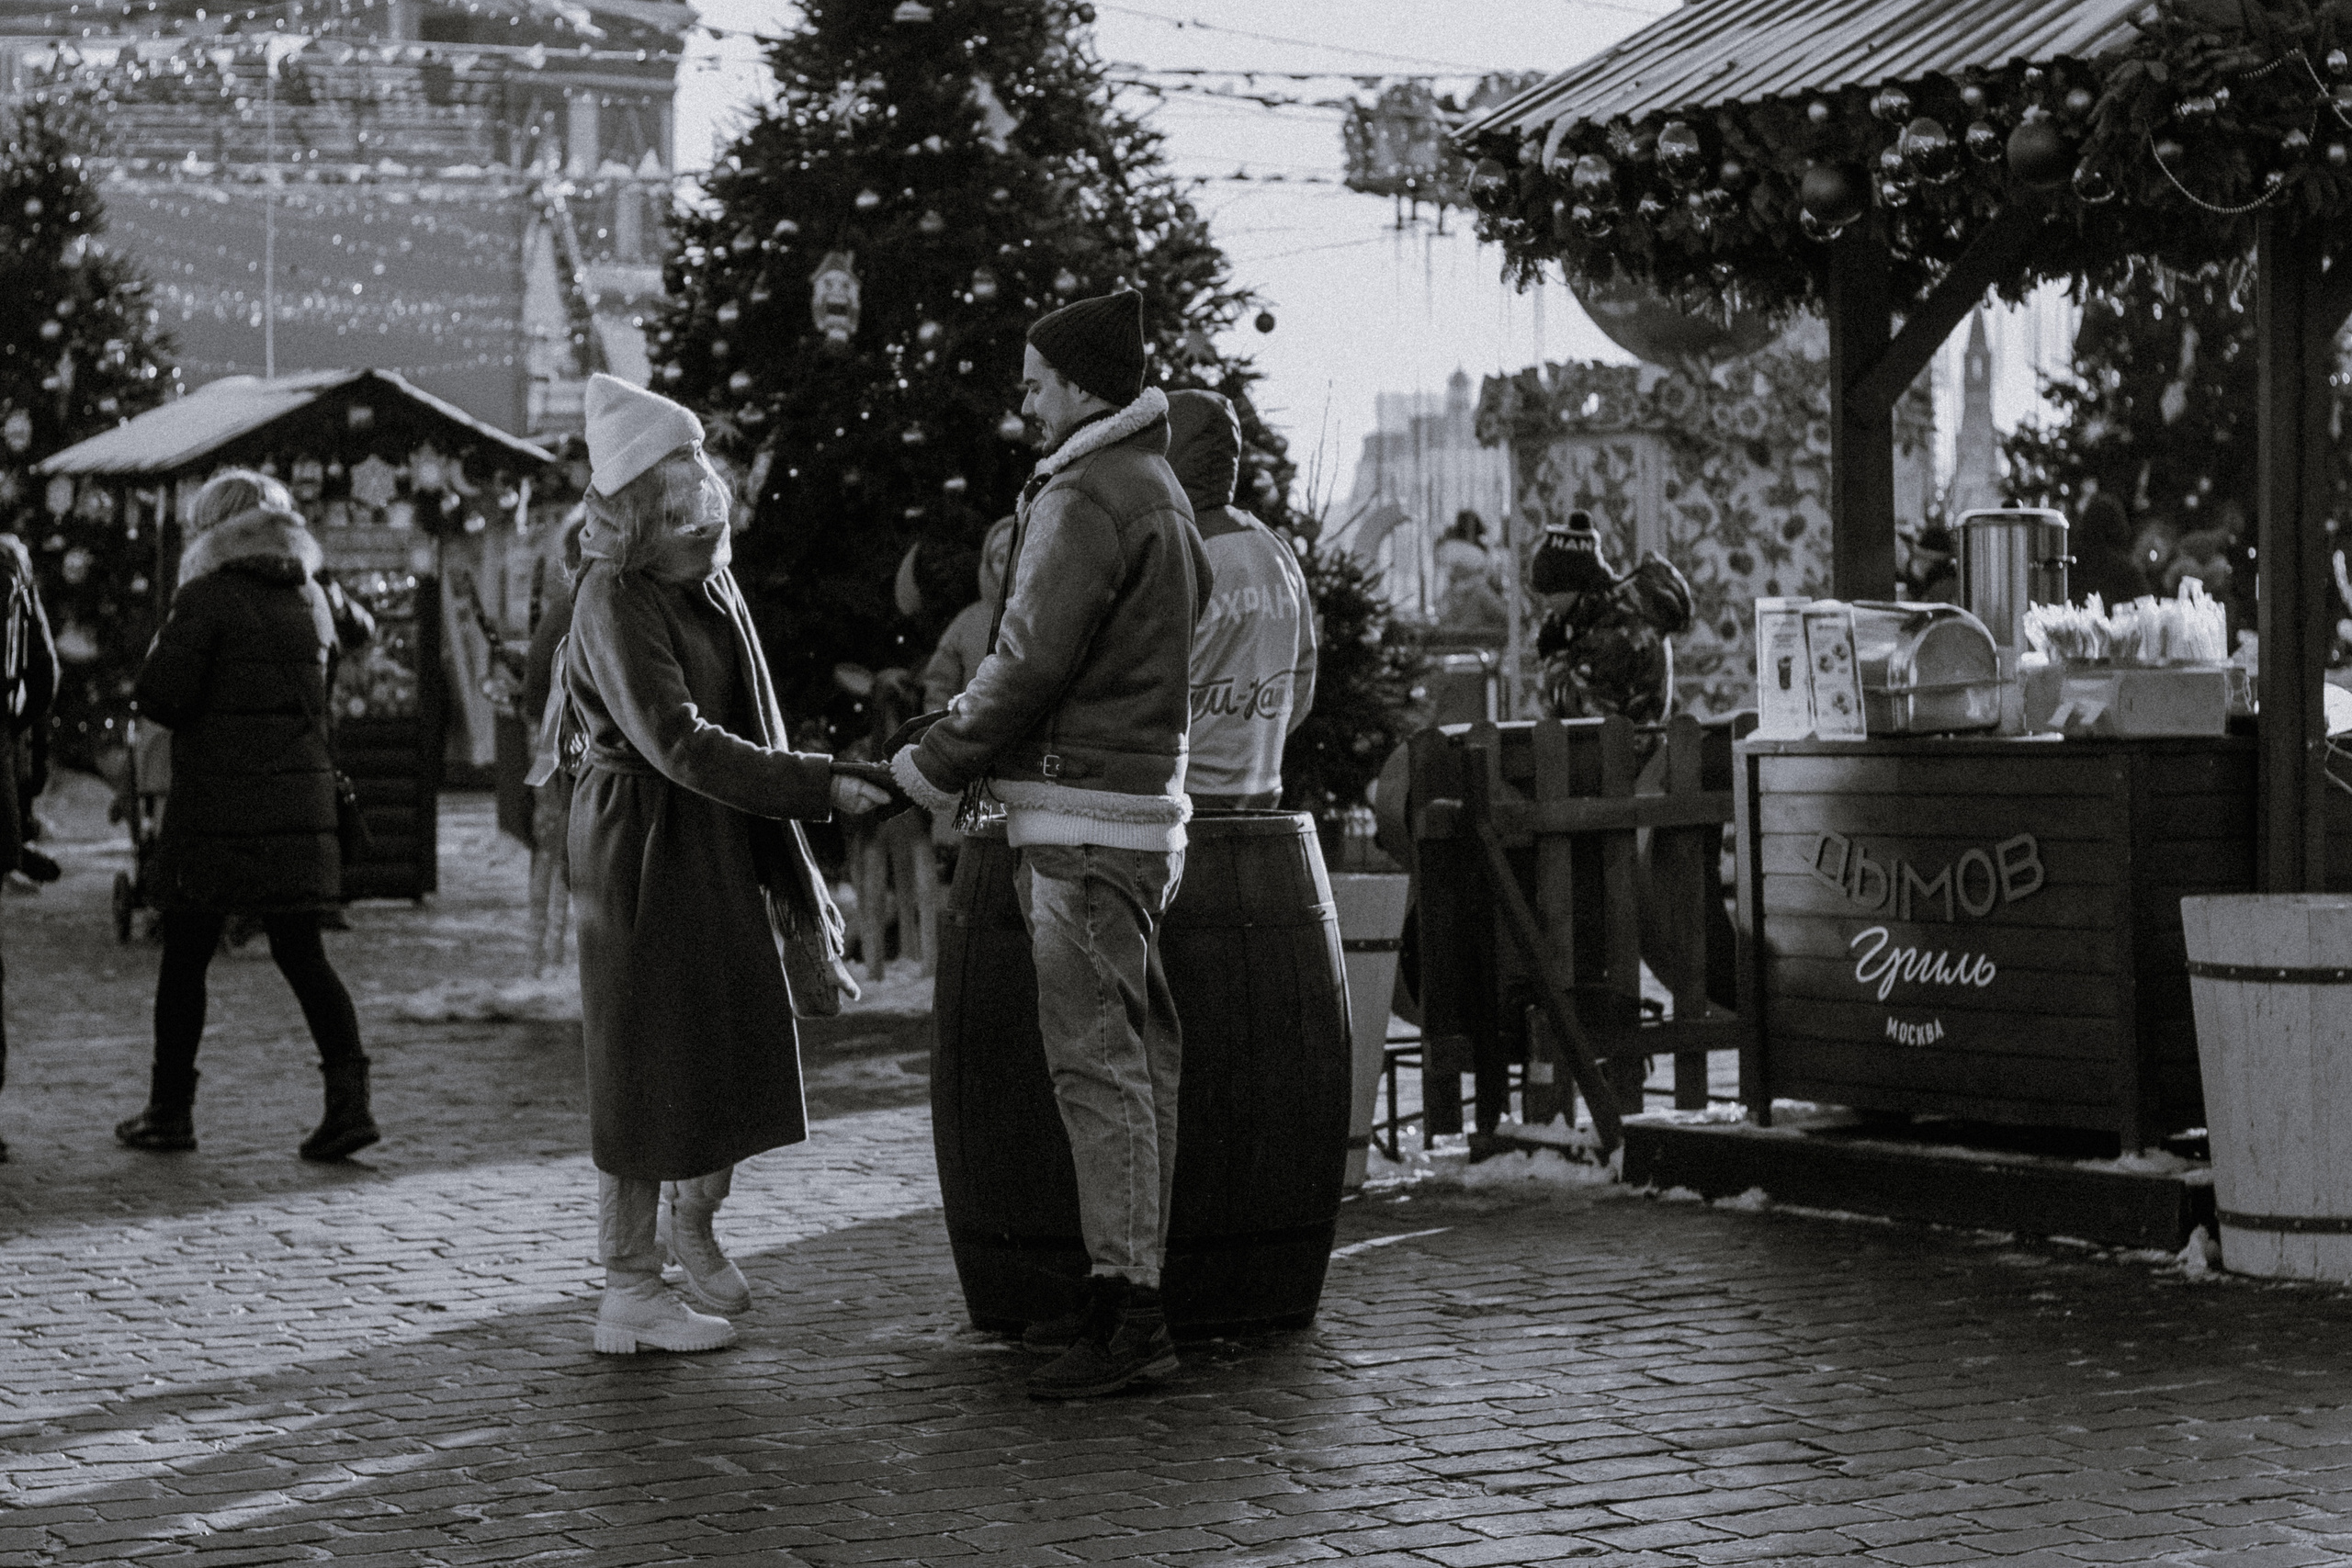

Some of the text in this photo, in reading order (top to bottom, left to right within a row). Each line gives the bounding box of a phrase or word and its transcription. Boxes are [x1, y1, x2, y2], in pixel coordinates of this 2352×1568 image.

[1802, 829, 2044, 921] ДЫМОВ
[1850, 926, 1996, 1001] Гриль
[1886, 1016, 1944, 1046] МОСКВА
